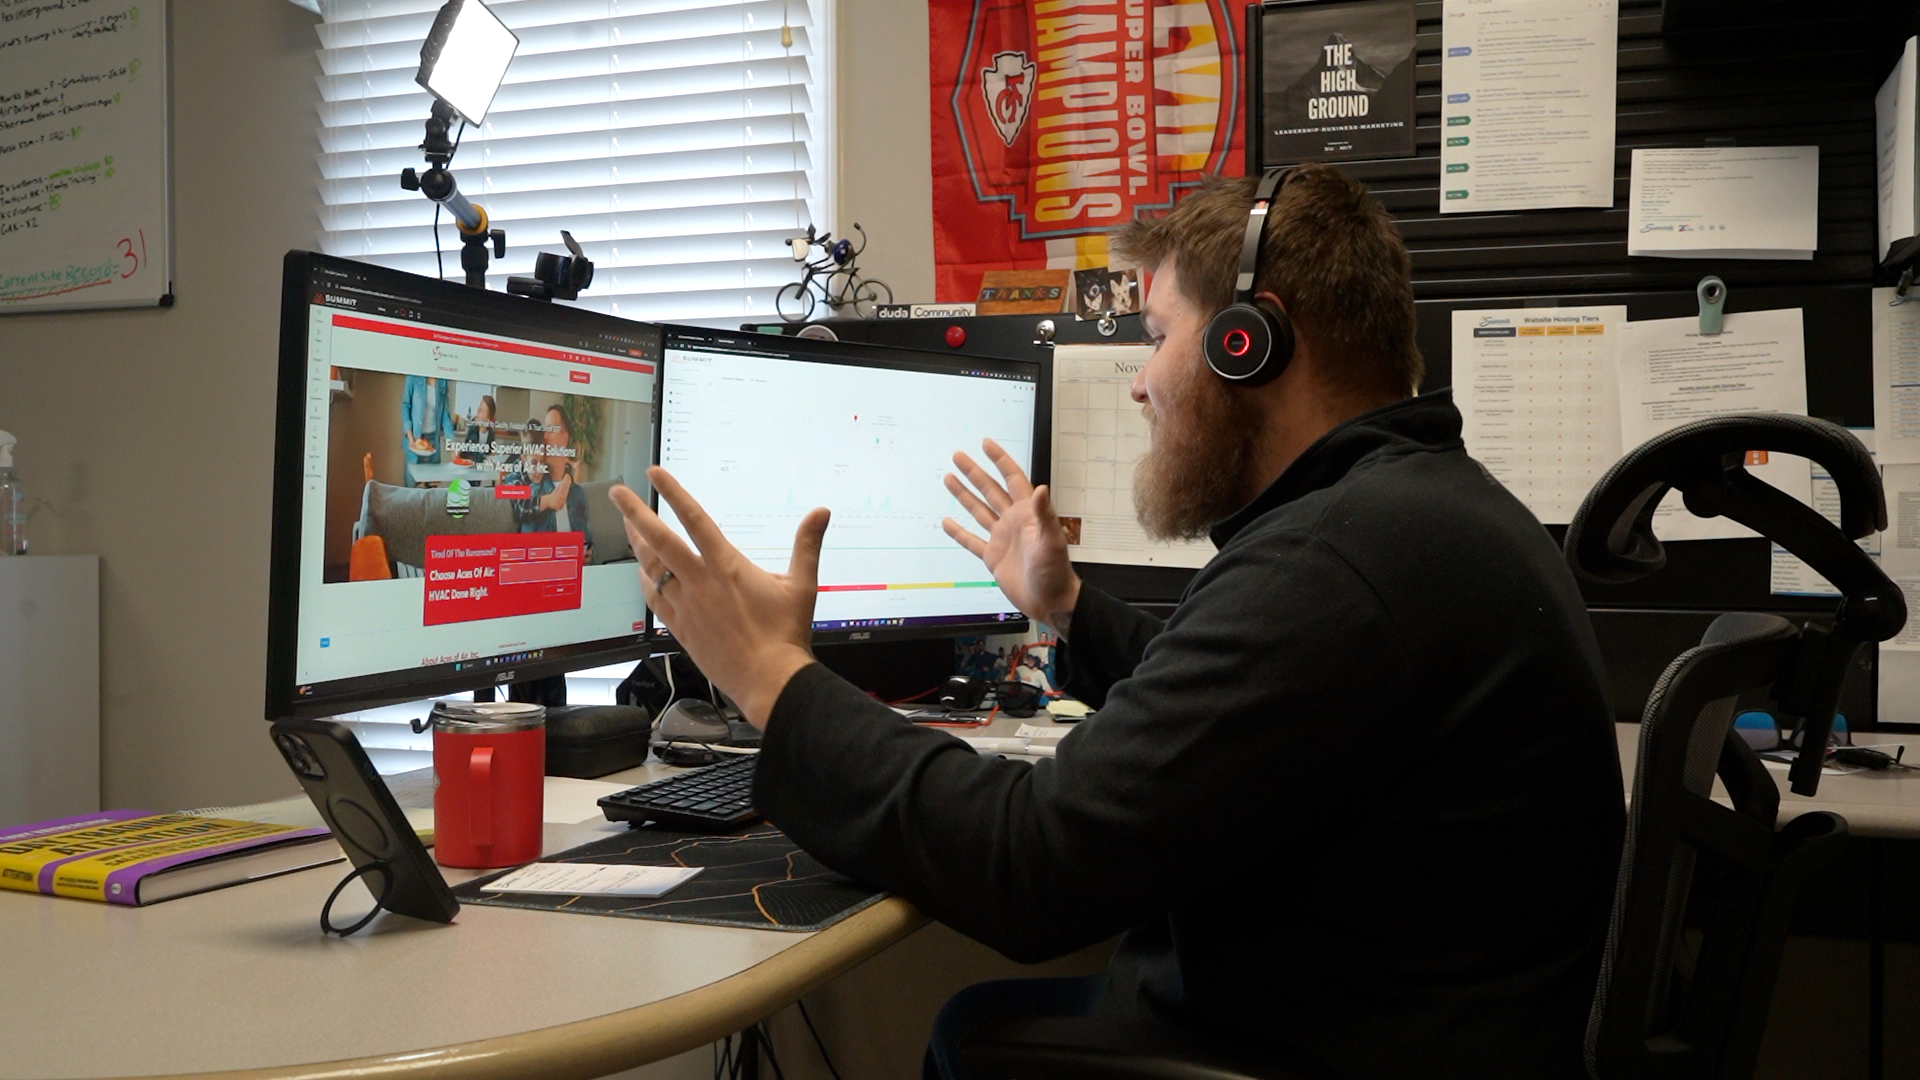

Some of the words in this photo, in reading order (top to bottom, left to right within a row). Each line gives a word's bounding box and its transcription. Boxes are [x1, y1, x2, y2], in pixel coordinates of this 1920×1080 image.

[1324, 44, 1353, 66] THE
[1320, 69, 1357, 93] HIGH
[1308, 95, 1369, 120] GROUND
[1125, 95, 1148, 195] BOWL
[117, 228, 147, 279] 31
[325, 294, 357, 306] SUMMIT
[878, 307, 909, 319] duda
[914, 306, 973, 318] Community
[1524, 316, 1552, 324] Website
[1553, 316, 1580, 325] Hosting
[445, 439, 490, 454] Experience
[491, 441, 522, 457] Superior
[523, 444, 545, 457] HVAC
[546, 445, 577, 458] Solutions
[476, 460, 493, 472] with
[495, 461, 513, 473] Aces
[429, 569, 456, 581] Choose
[456, 568, 473, 580] Aces
[474, 567, 483, 578] Of
[428, 589, 450, 602] HVAC
[451, 588, 469, 600] Done
[849, 631, 871, 641] ASUS
[494, 670, 516, 682] ASUS
